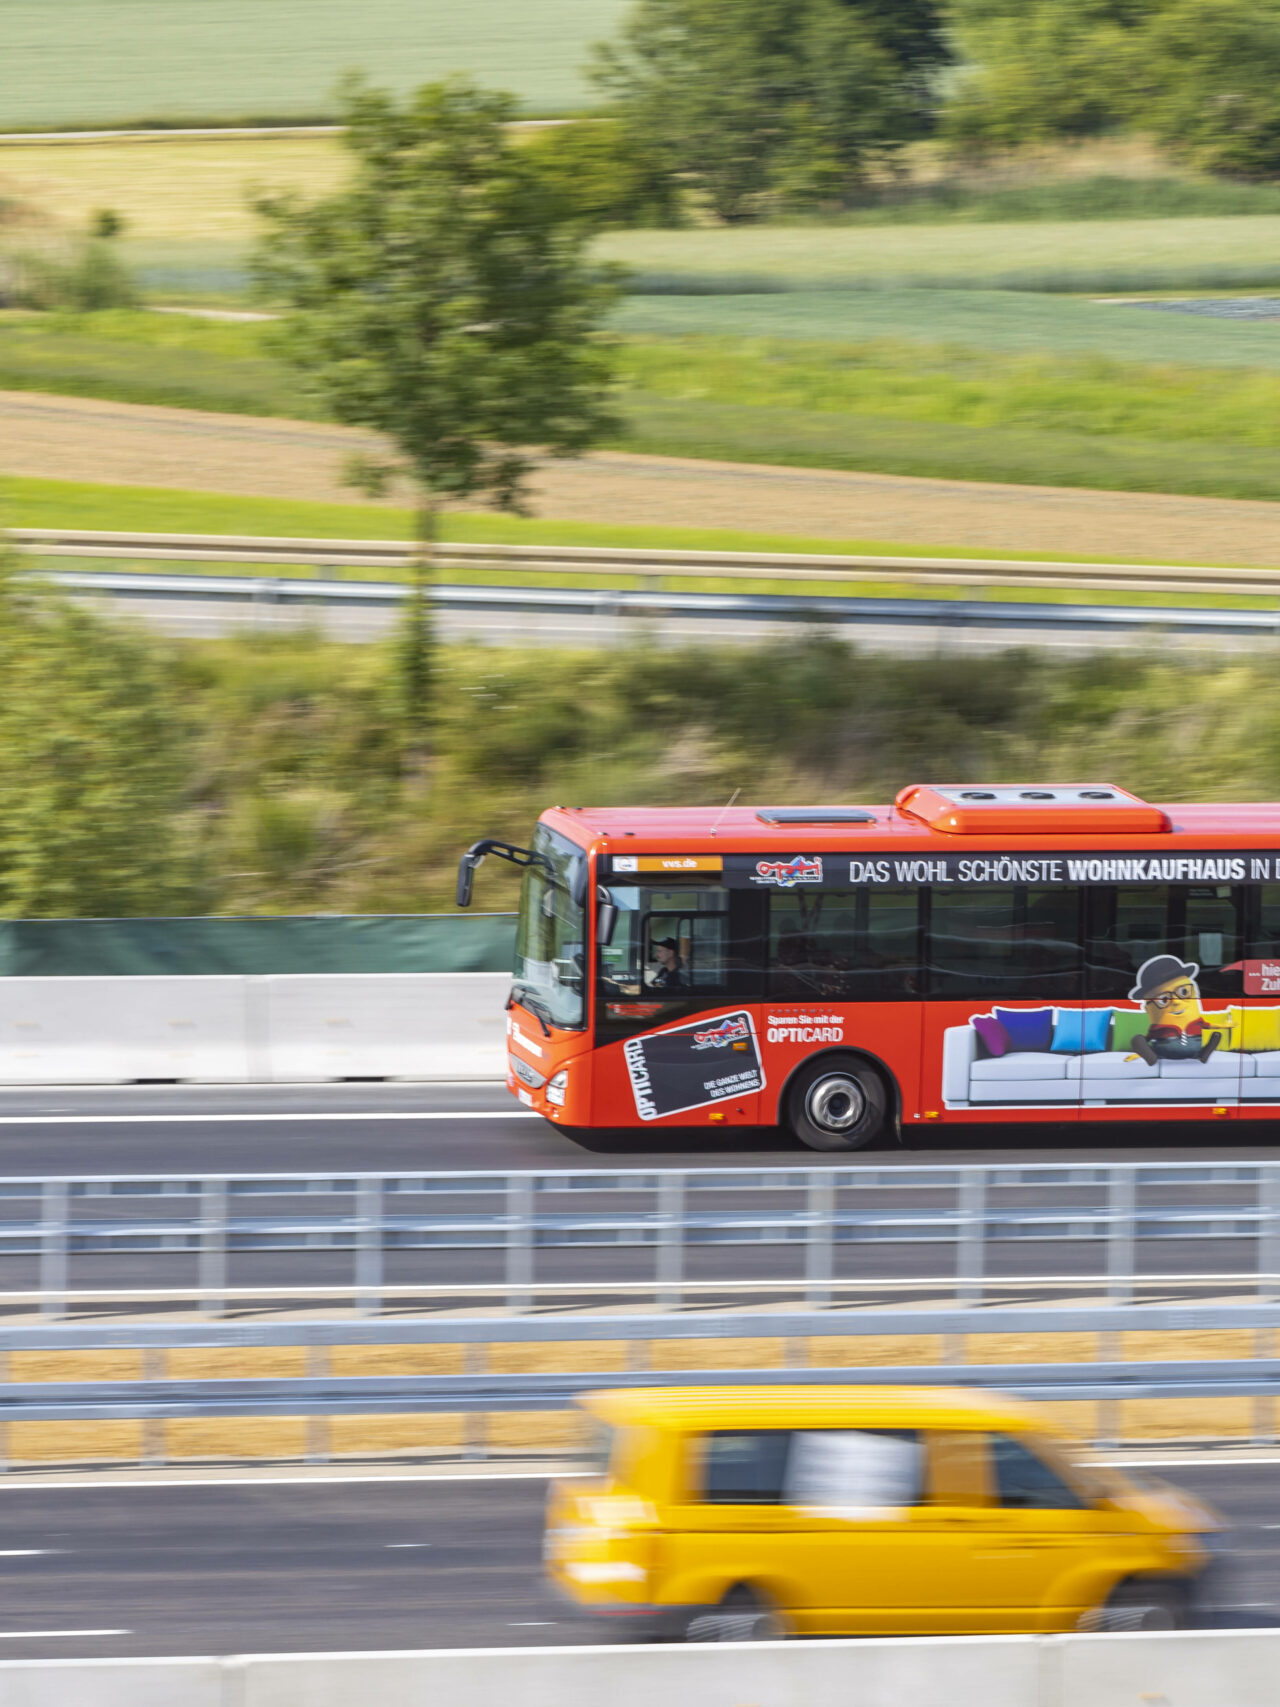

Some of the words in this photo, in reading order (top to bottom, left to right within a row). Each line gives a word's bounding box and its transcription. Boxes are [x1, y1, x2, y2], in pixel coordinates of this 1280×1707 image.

[850, 861, 890, 882] DAS
[894, 861, 954, 882] WOHL
[958, 856, 1062, 882] SCHÖNSTE
[1067, 858, 1245, 881] WOHNKAUFHAUS
[1250, 858, 1270, 880] IN
[767, 1015, 798, 1026] Sparen
[799, 1015, 813, 1025] Sie
[814, 1015, 829, 1025] mit
[829, 1015, 845, 1025] der
[767, 1027, 844, 1043] OPTICARD
[626, 1039, 658, 1117] OPTICARD
